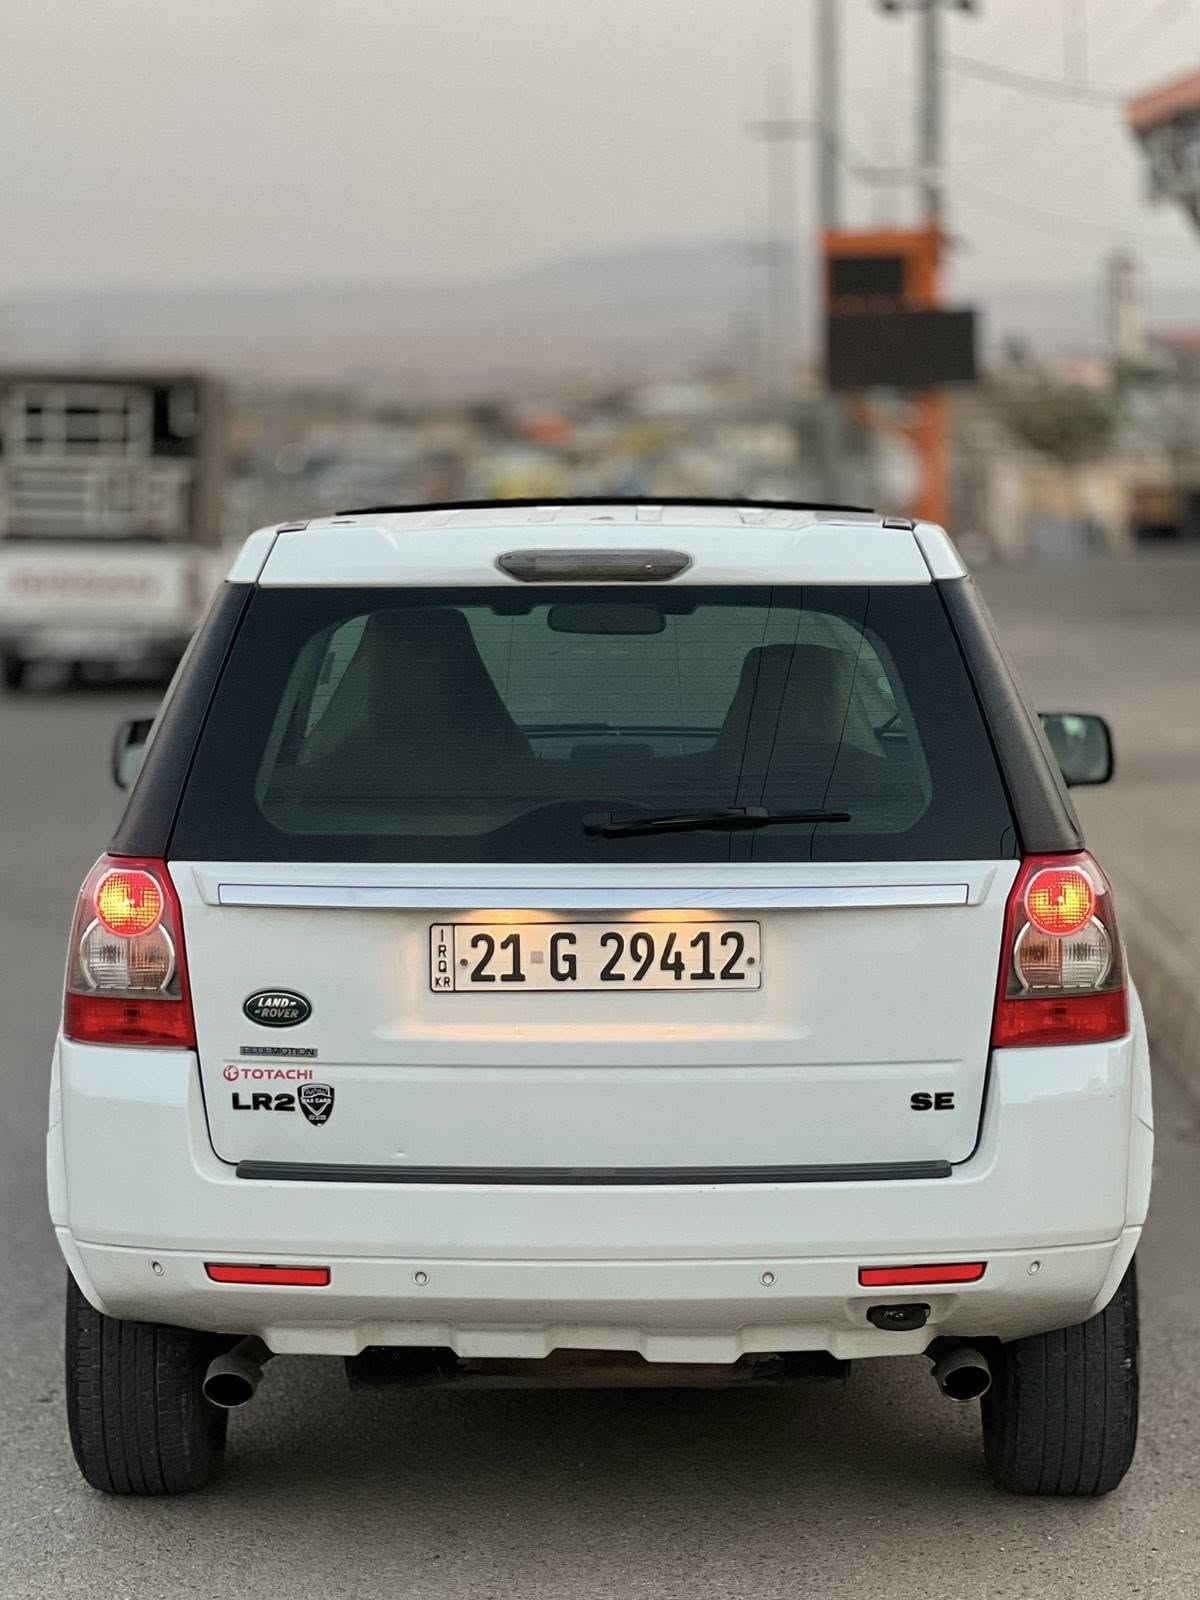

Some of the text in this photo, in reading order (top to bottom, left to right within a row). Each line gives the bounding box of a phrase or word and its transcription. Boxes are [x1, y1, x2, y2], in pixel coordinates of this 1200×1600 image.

[470, 931, 745, 982] 21 G 29412
[258, 997, 290, 1008] LAND
[261, 1008, 299, 1018] ROVER
[240, 1068, 313, 1080] TOTACHI
[232, 1092, 296, 1112] LR2
[910, 1092, 955, 1111] SE
